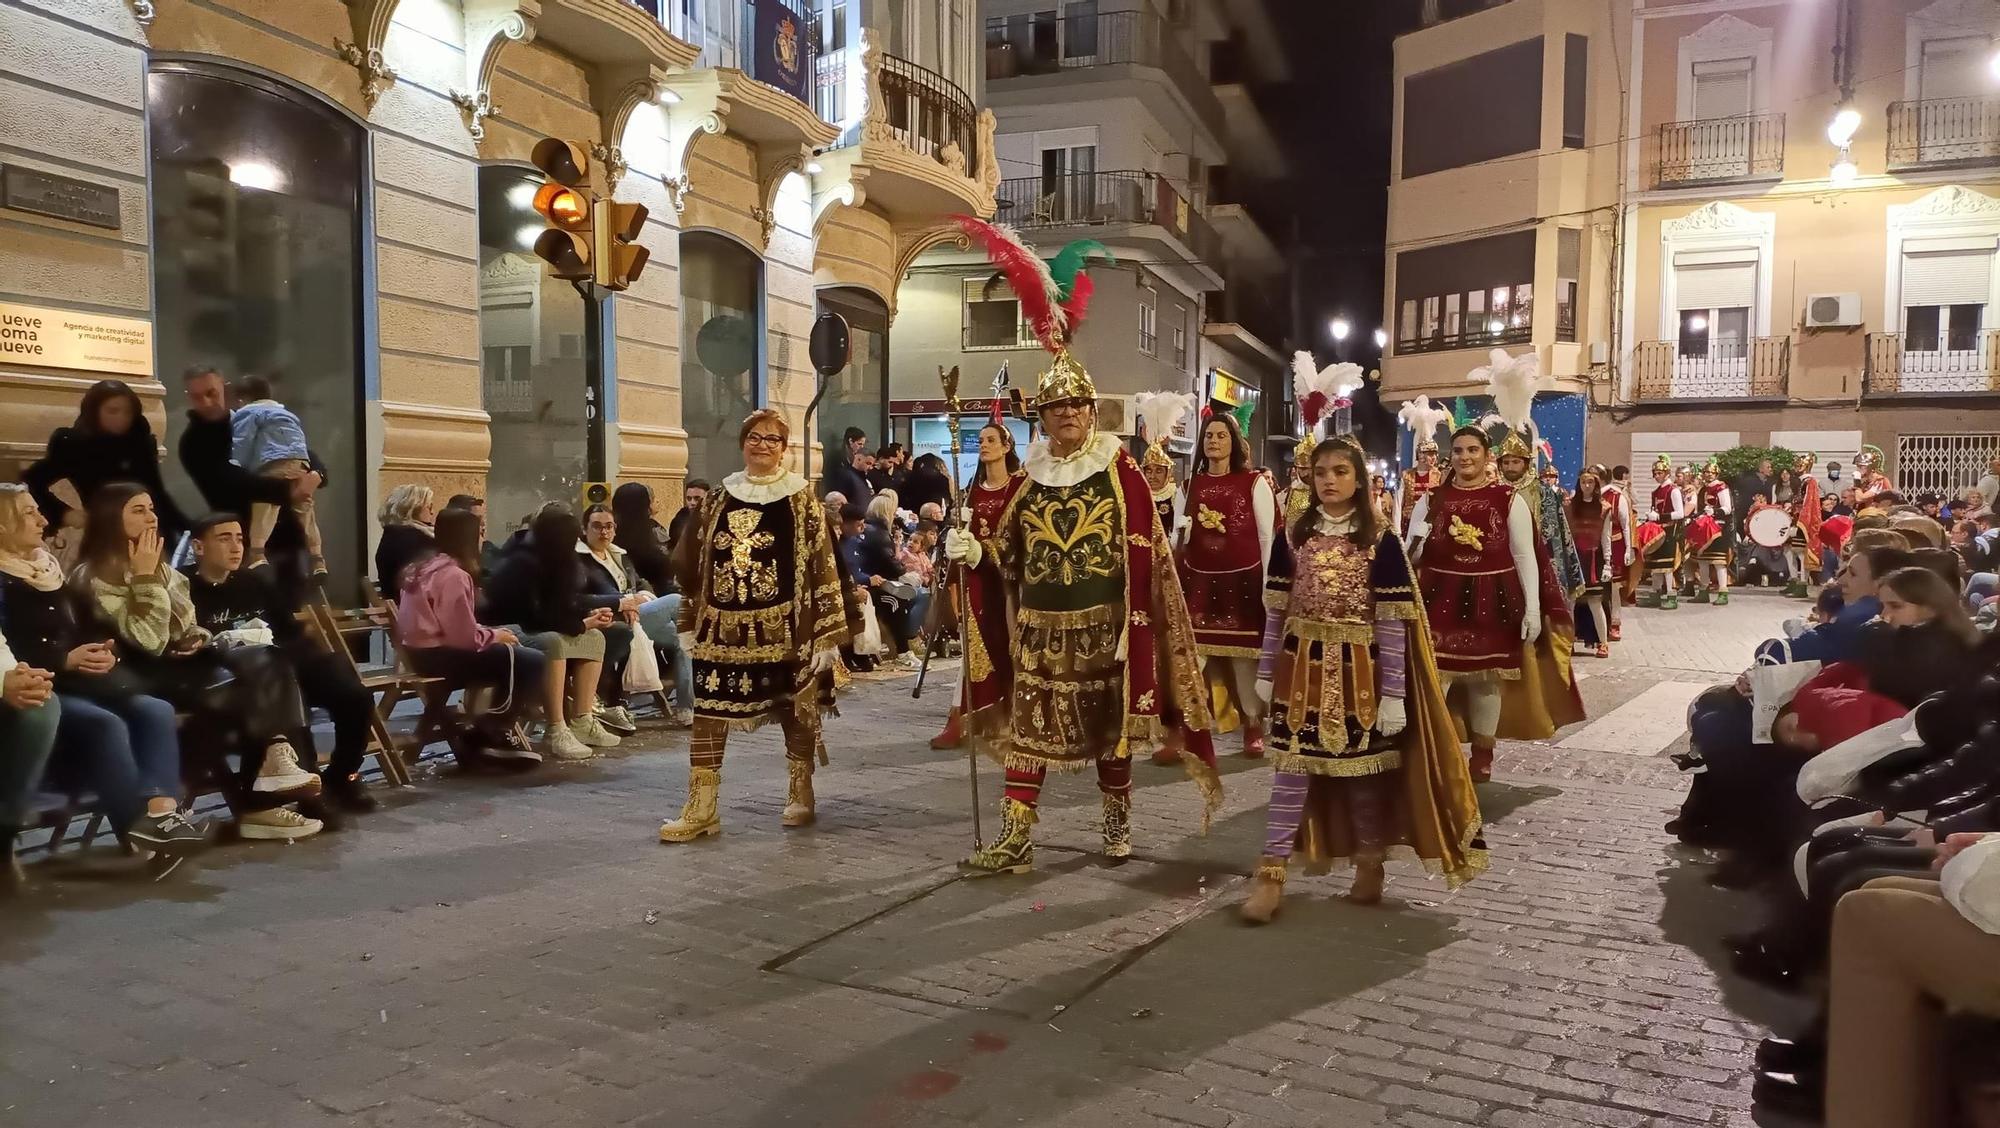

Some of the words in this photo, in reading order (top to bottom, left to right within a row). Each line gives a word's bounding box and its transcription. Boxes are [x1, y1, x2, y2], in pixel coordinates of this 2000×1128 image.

[2, 314, 42, 328] ueve
[0, 328, 37, 341] oma
[63, 322, 93, 332] Agencia
[105, 328, 144, 338] creatividad
[84, 333, 121, 344] marketing
[123, 336, 145, 345] digital
